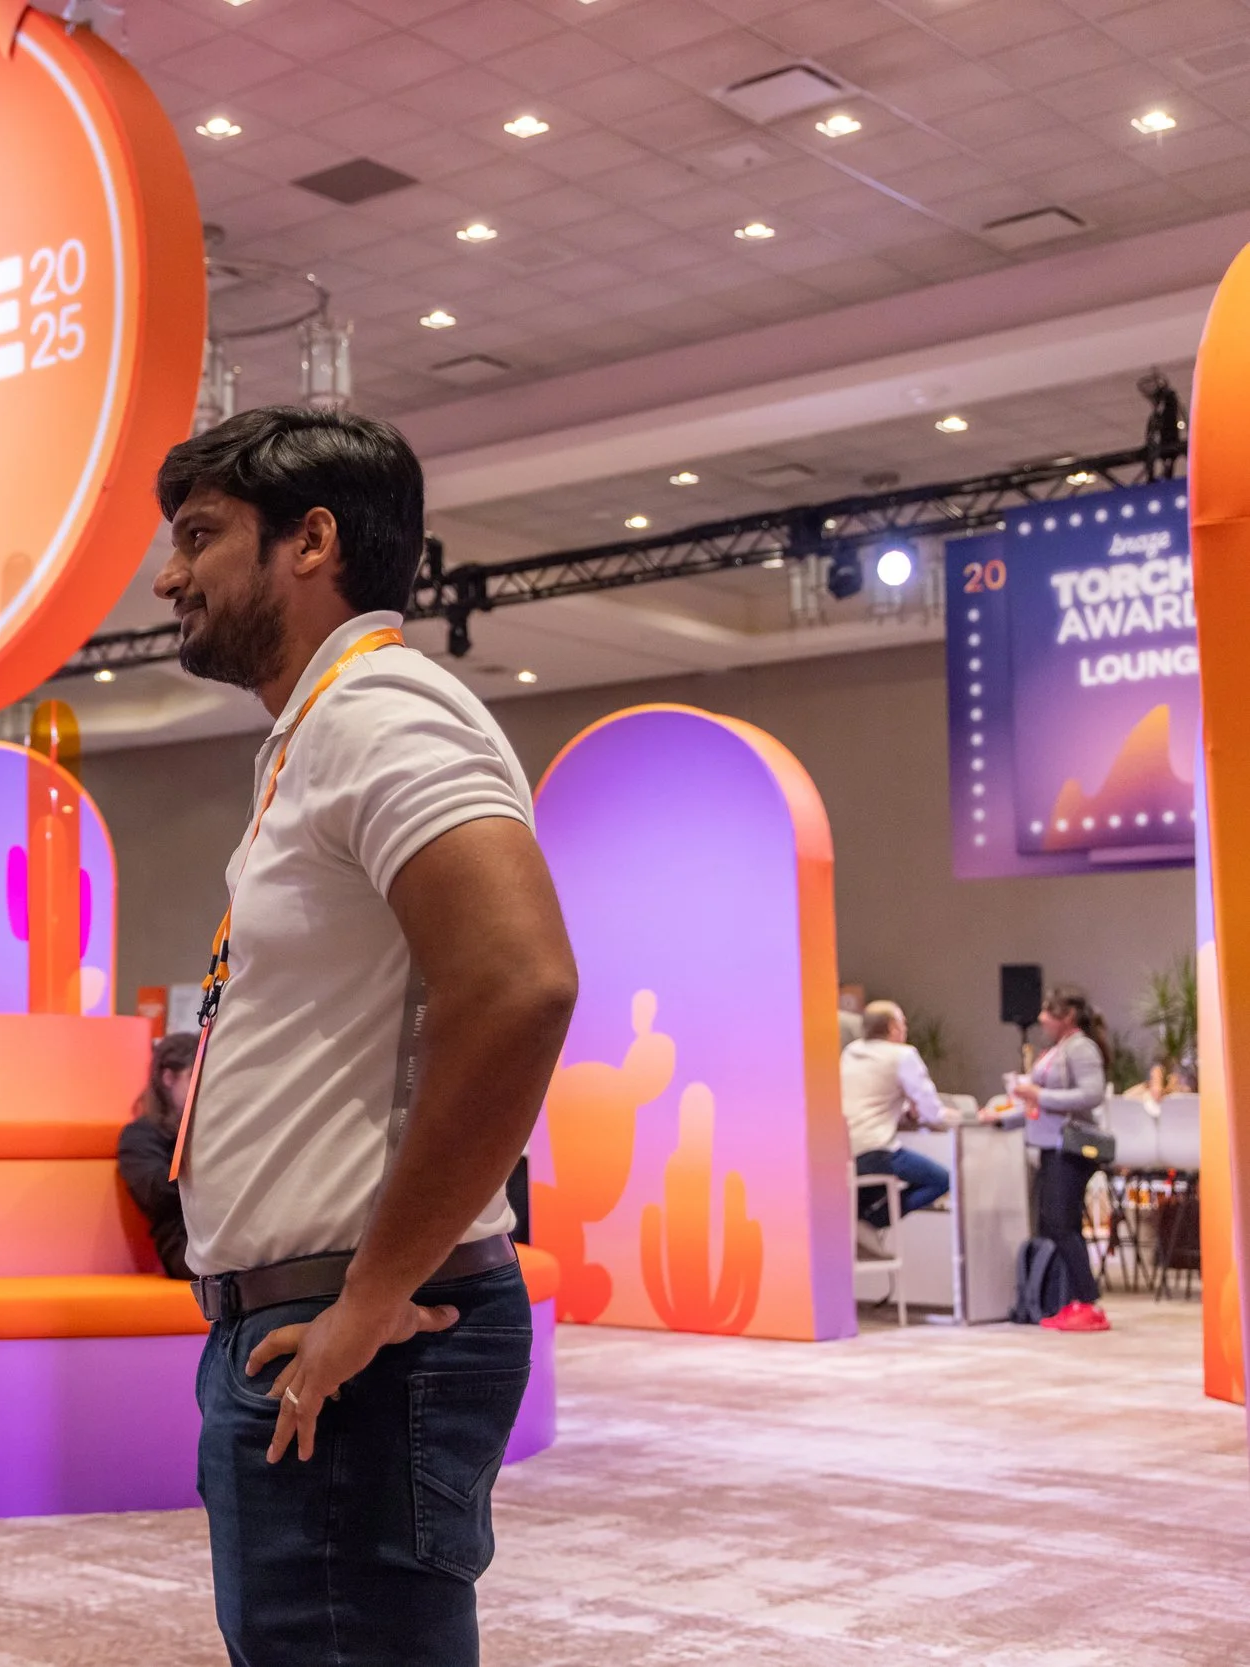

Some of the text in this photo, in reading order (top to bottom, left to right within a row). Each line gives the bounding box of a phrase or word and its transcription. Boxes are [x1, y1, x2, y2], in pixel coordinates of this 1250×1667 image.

[29, 238, 86, 306] 20
[30, 303, 85, 370] 25
[963, 559, 1006, 593] 20
[1050, 554, 1193, 609] TORCH
